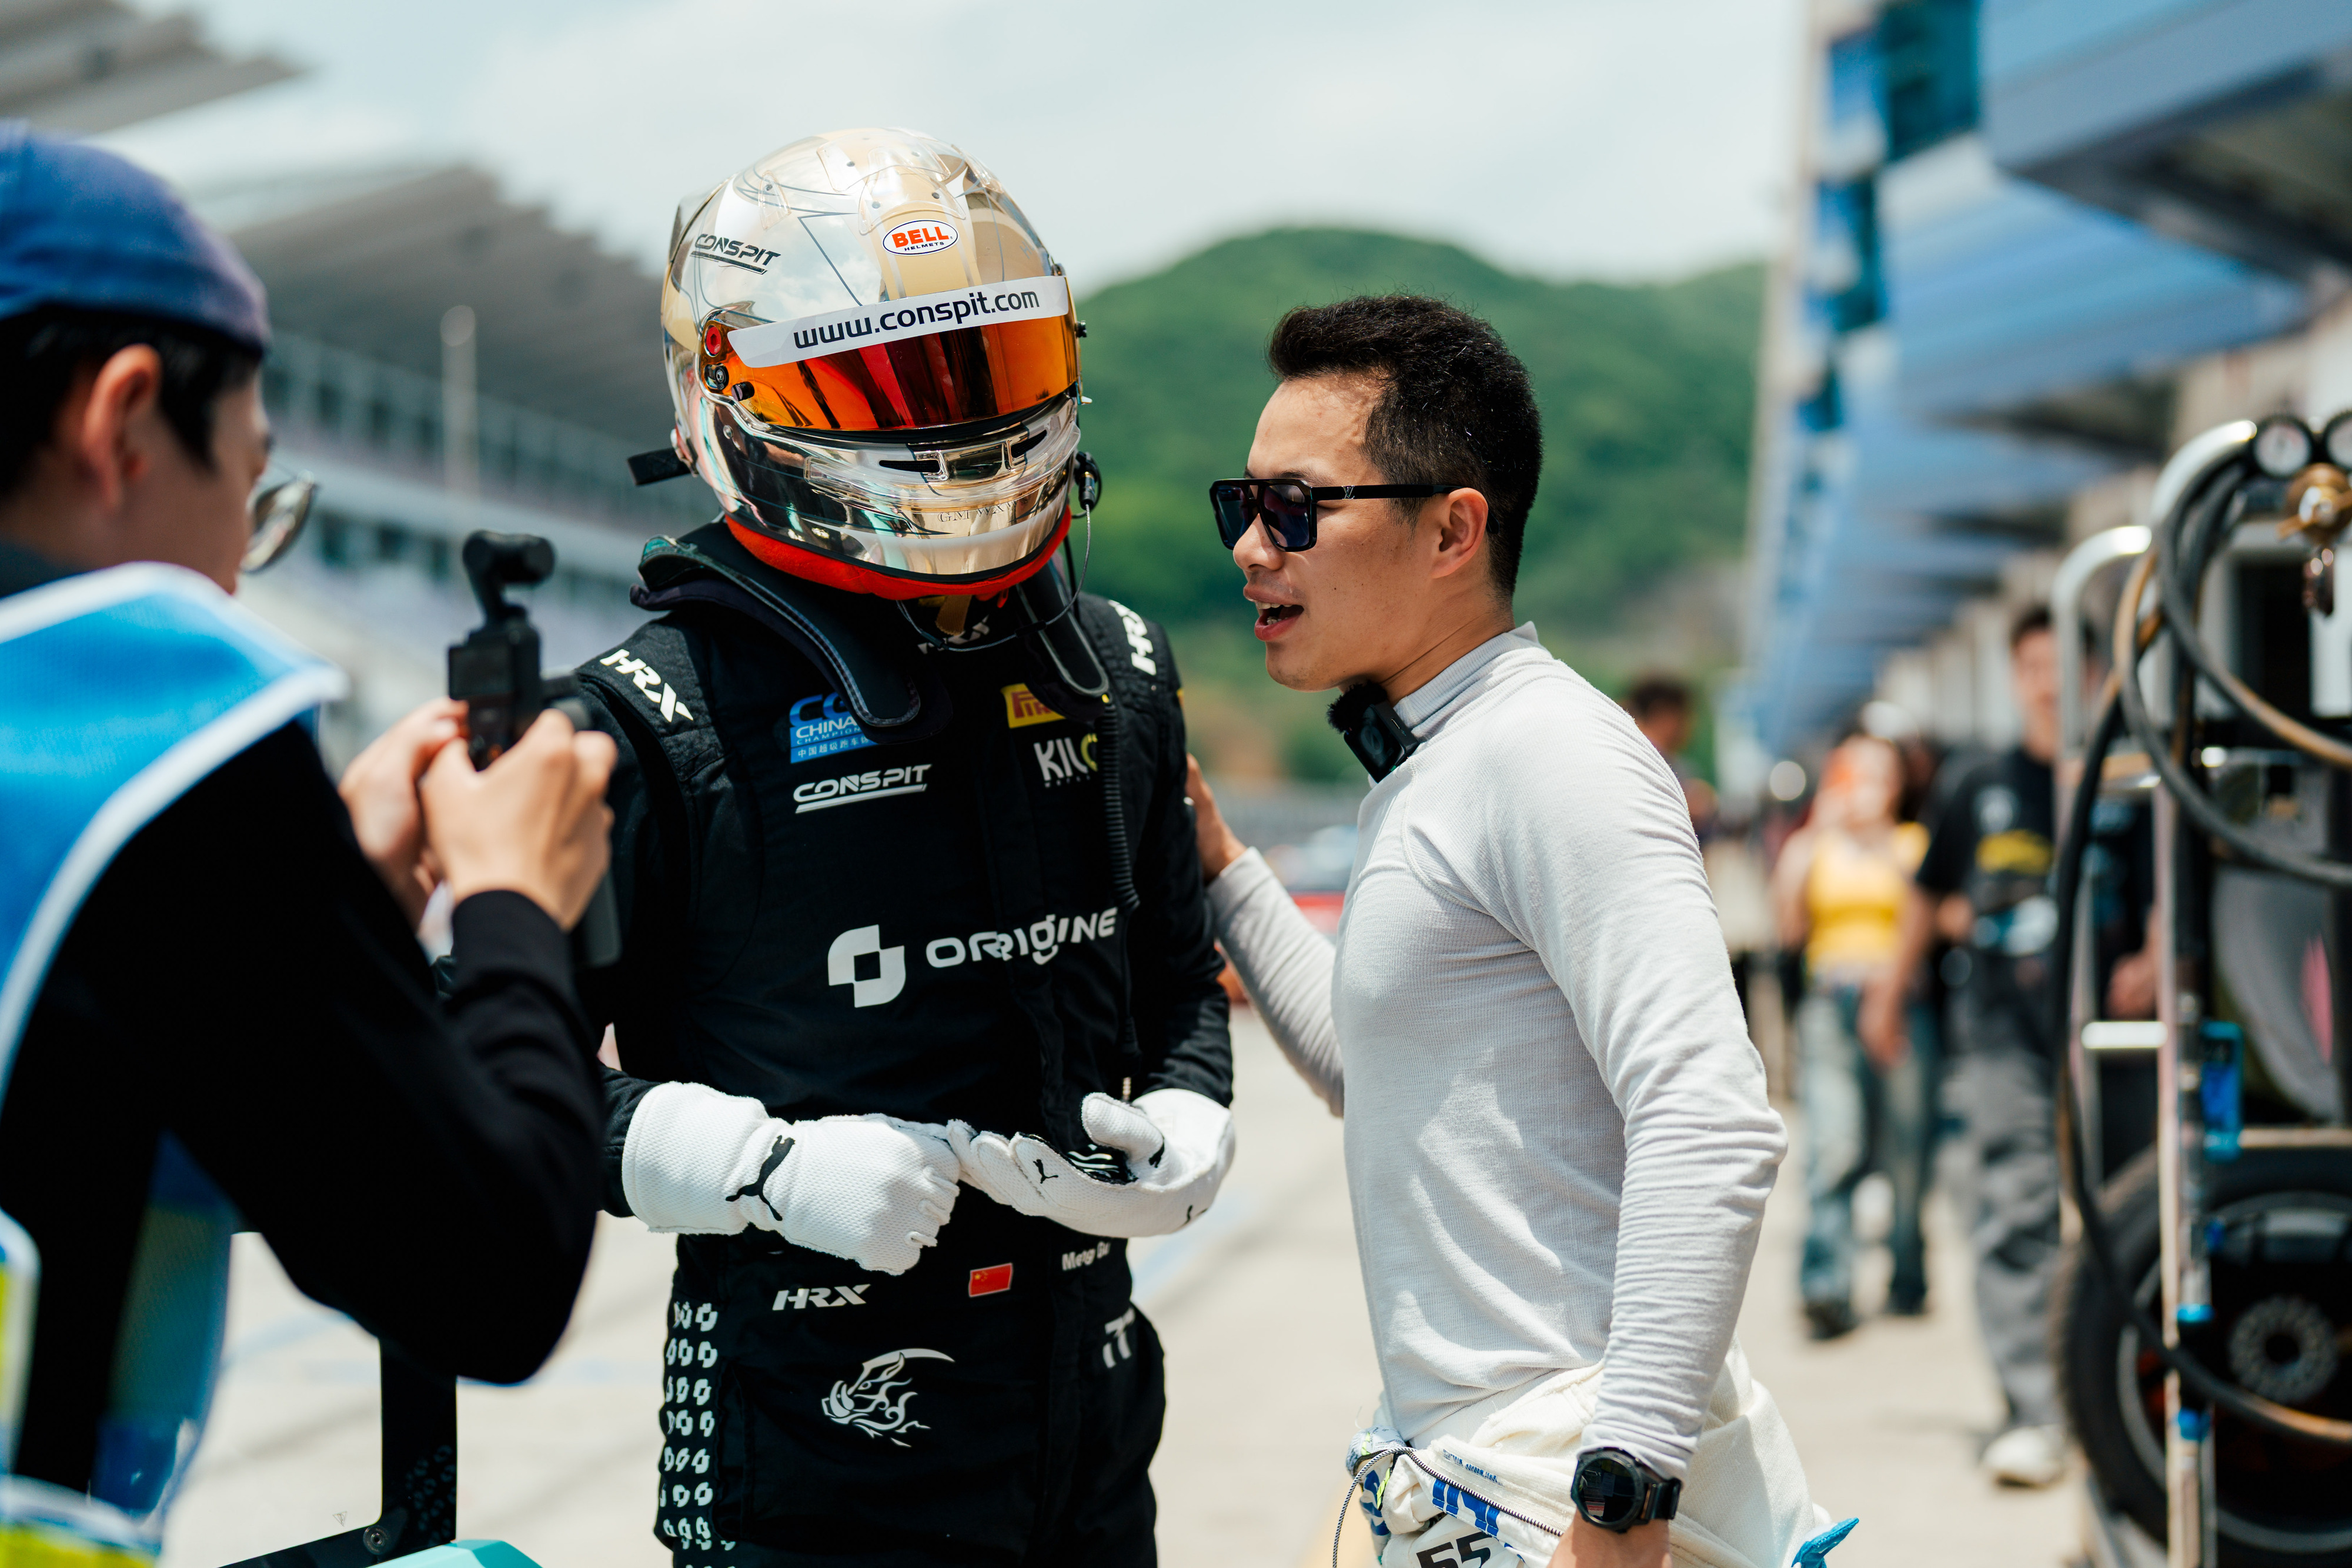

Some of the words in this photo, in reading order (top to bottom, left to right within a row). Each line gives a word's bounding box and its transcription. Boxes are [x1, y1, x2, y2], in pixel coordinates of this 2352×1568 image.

[694, 233, 781, 266] CONSPIT
[891, 226, 949, 248] BELL
[904, 242, 945, 252] HELMETS
[794, 292, 1040, 349] www.conspit.com
[599, 648, 694, 722] HRX
[796, 716, 858, 738] CHINA
[797, 727, 861, 745] CHAMPION
[793, 764, 931, 804] CONSPIT
[772, 1283, 871, 1311] HRX
